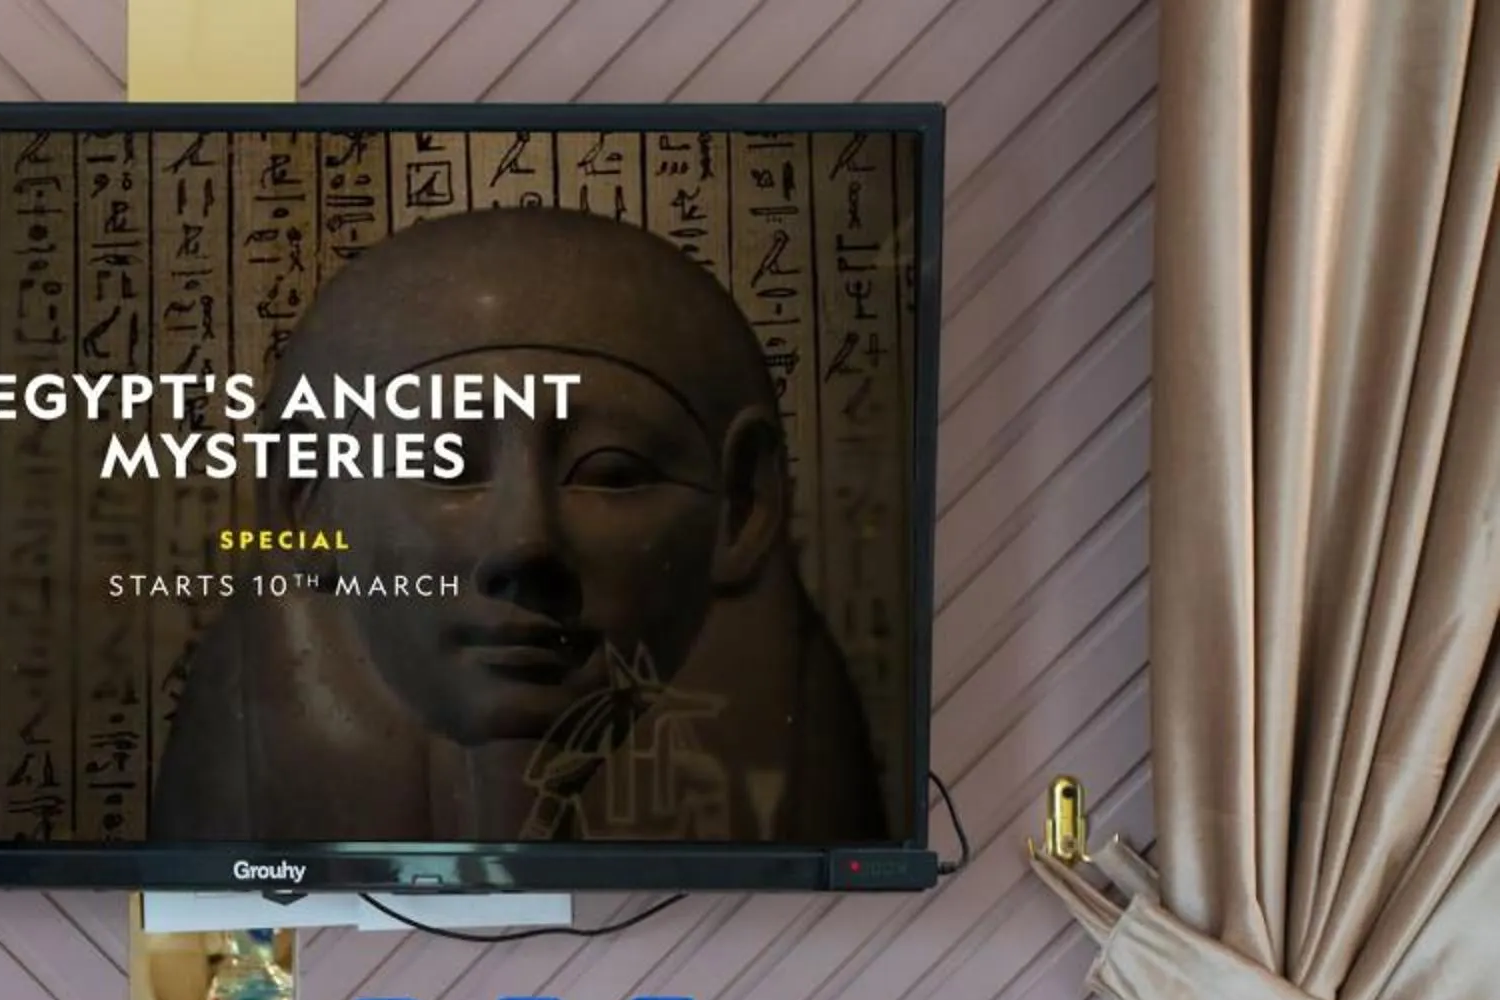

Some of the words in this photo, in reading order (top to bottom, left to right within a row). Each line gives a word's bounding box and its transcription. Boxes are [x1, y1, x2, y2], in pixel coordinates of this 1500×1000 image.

[280, 373, 581, 420] ANCIENT
[100, 432, 465, 479] MYSTERIES
[220, 530, 349, 550] SPECIAL
[109, 574, 235, 597] STARTS
[335, 574, 459, 597] MARCH
[233, 860, 307, 883] Grouhy
